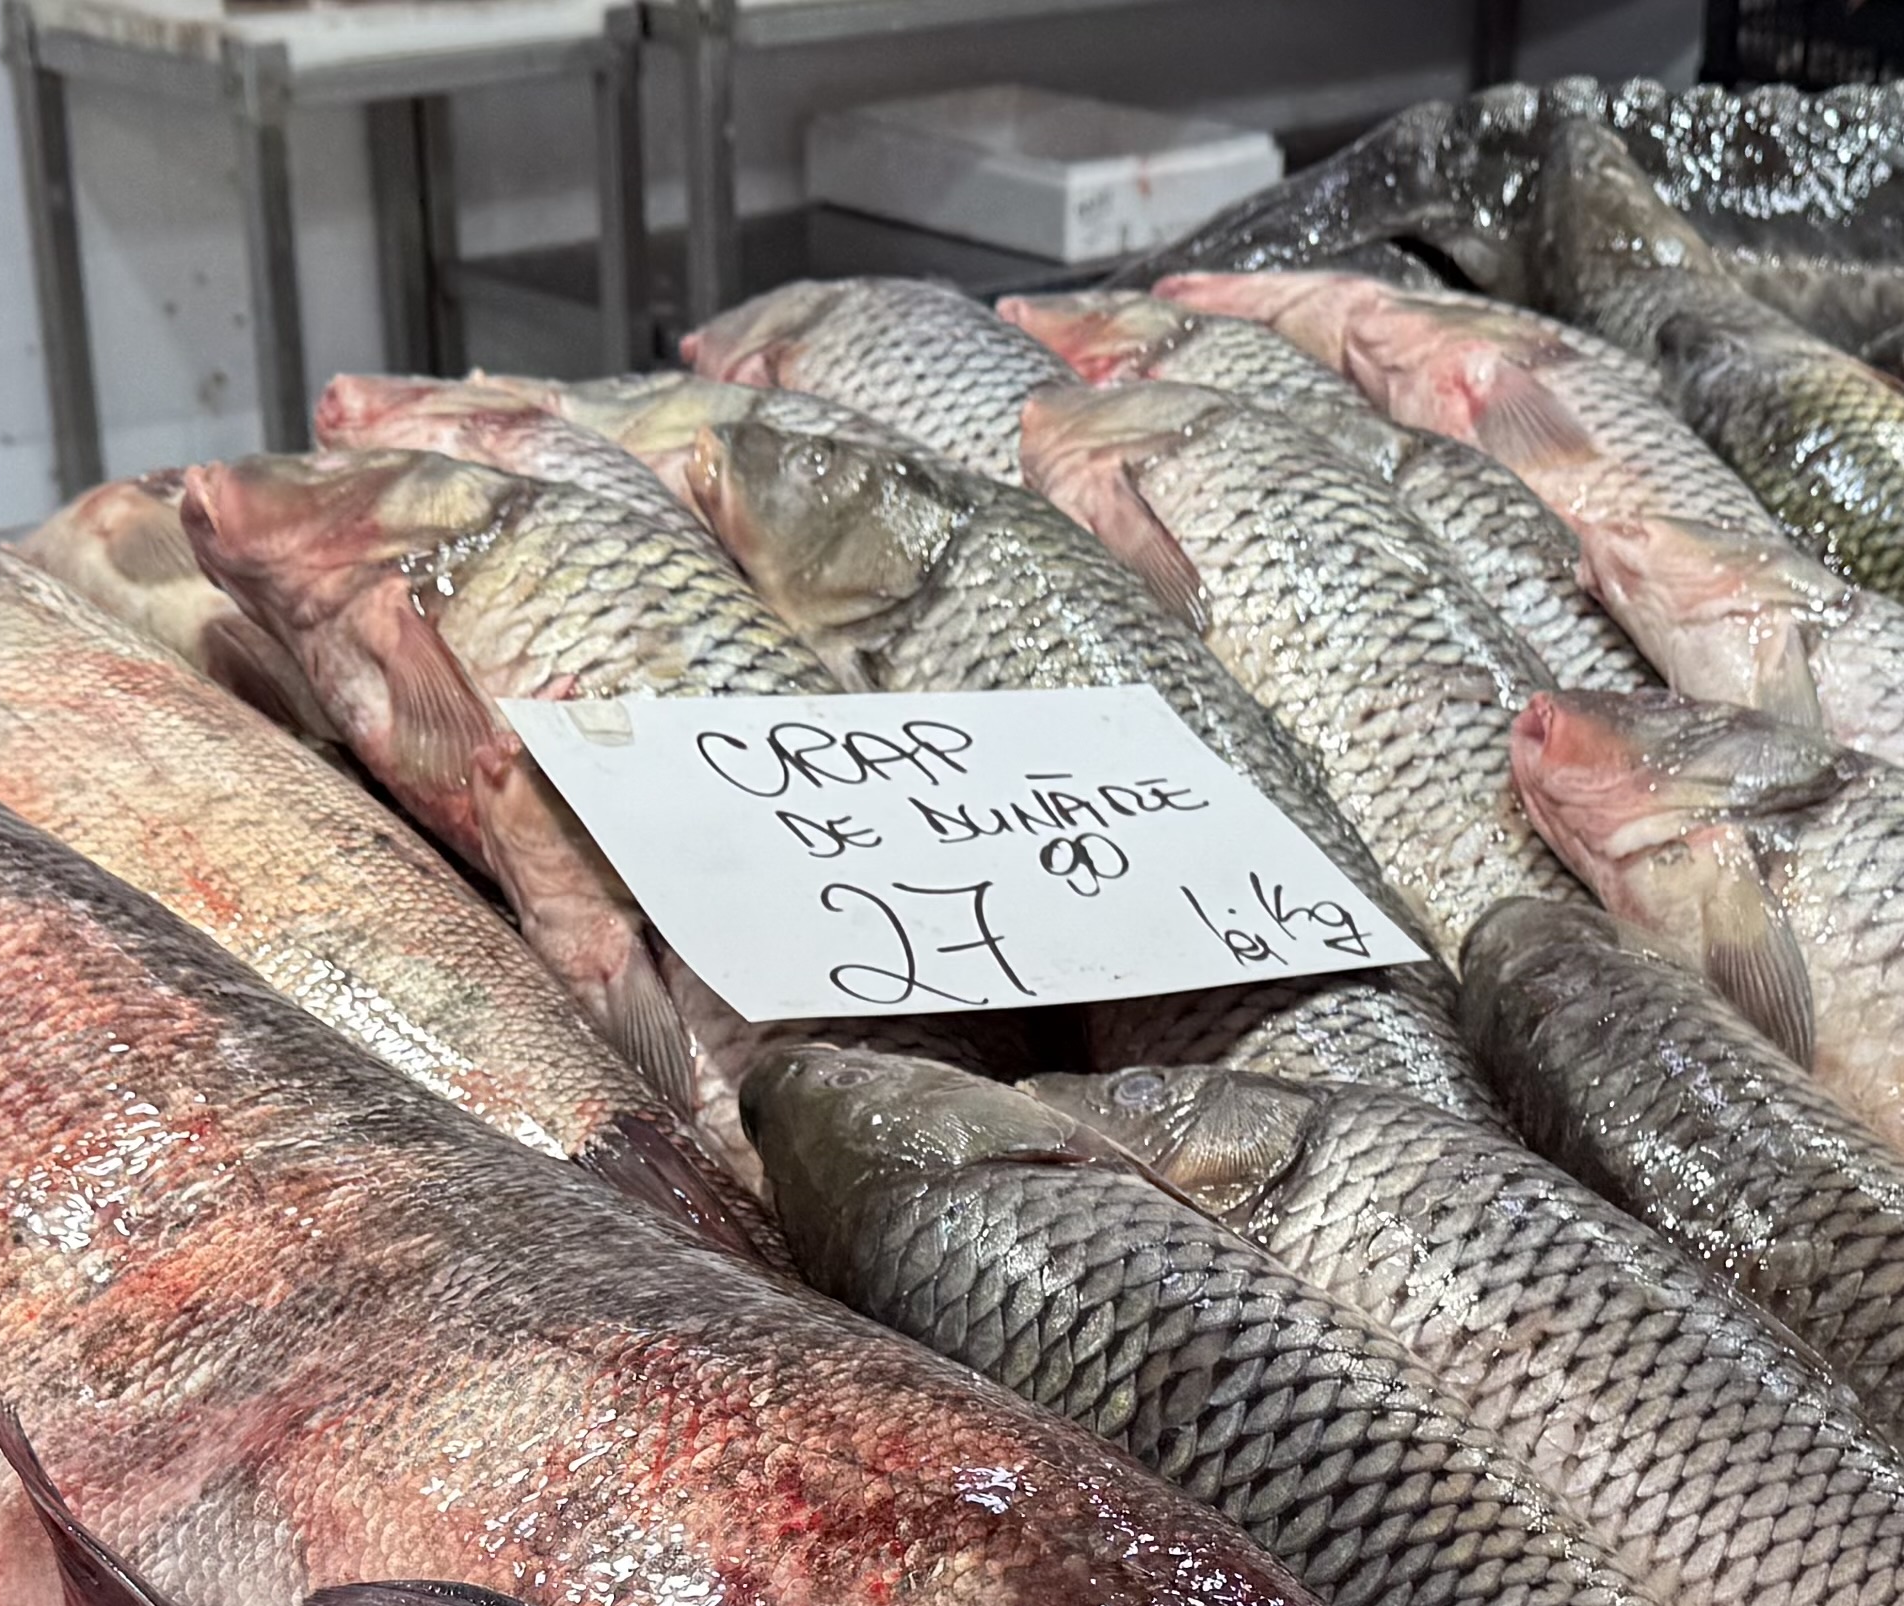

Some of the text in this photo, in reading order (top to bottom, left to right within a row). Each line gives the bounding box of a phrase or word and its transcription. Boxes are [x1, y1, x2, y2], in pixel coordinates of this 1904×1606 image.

[697, 720, 973, 798] CRAP
[775, 810, 883, 859] DE
[820, 879, 1036, 1004] 27
